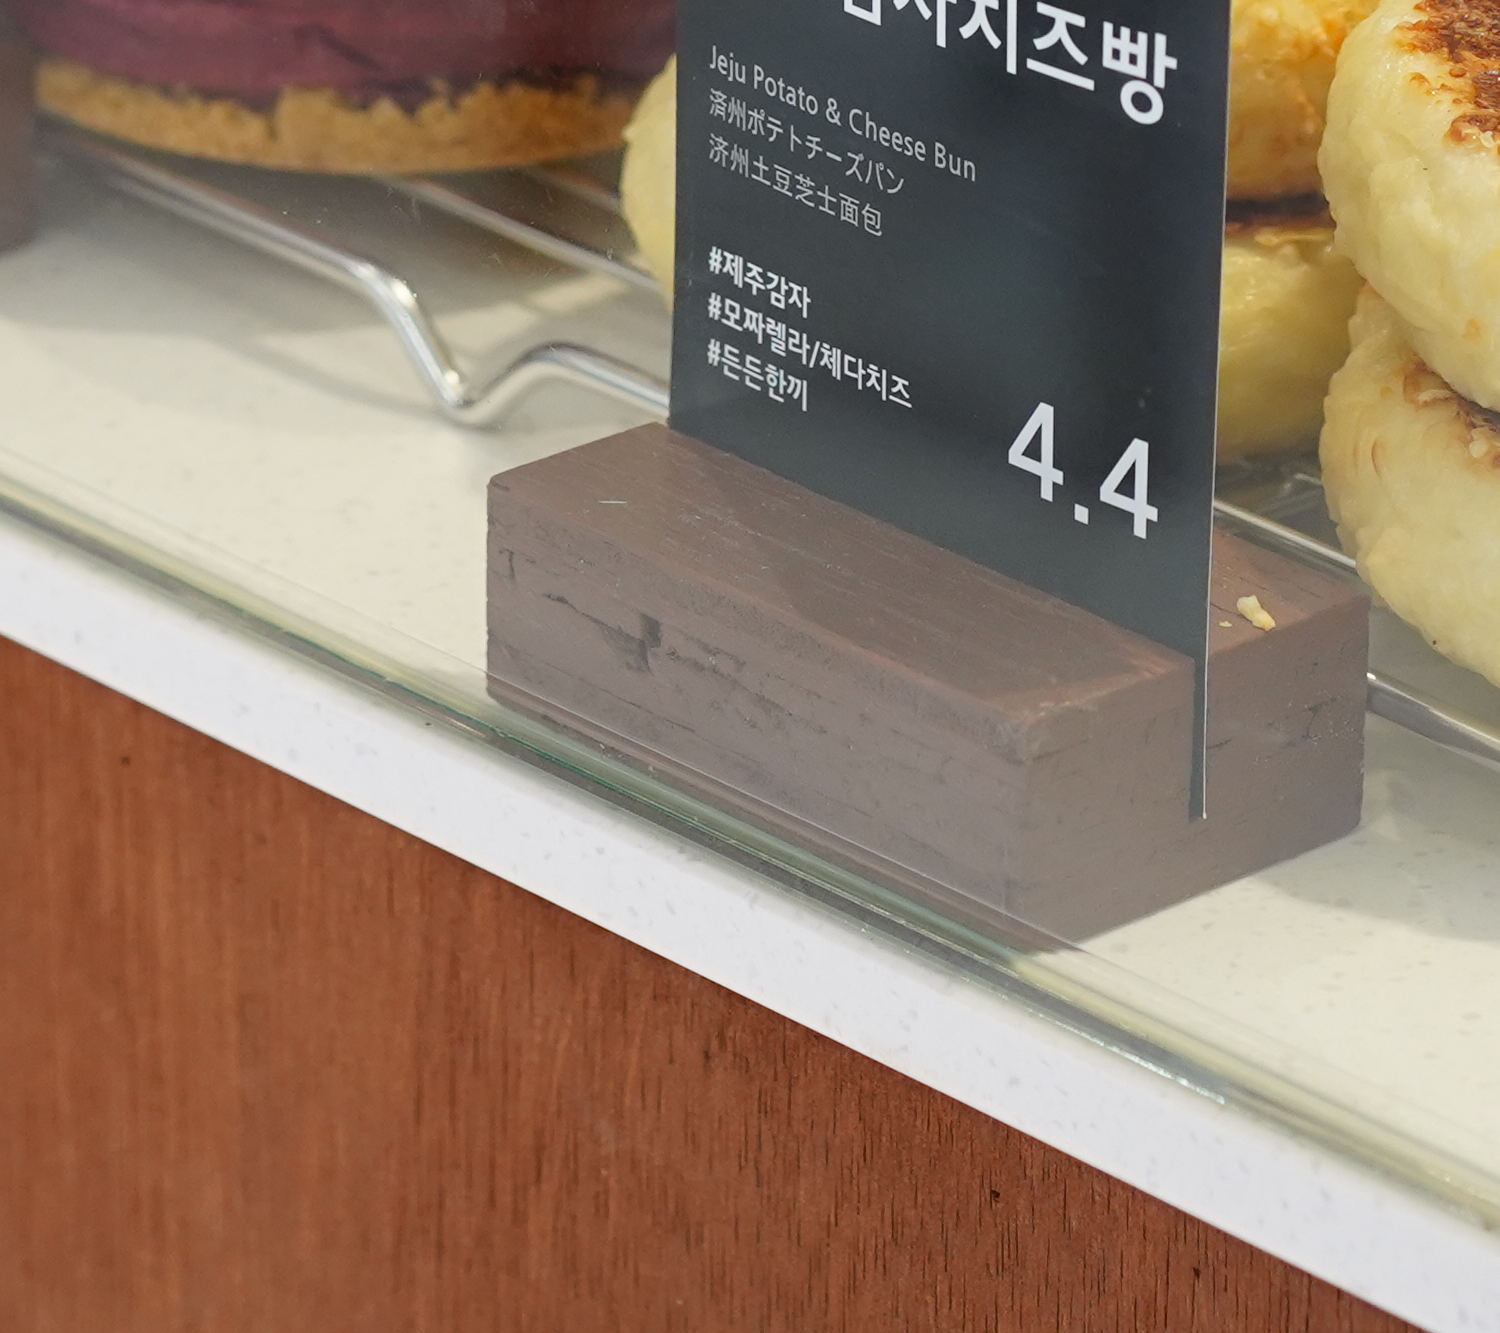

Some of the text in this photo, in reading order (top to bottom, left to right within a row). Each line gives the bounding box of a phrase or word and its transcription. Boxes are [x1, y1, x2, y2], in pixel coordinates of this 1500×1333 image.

[709, 45, 976, 182] Jeju Potato & Cheese Bun
[709, 87, 904, 194] 済州ポテトチーズパン
[709, 133, 883, 237] 济州土豆芝士面包
[708, 246, 811, 319] #제주감자
[707, 338, 808, 412] #든든한끼
[708, 291, 913, 408] #모짜렐라/체다치즈
[1007, 401, 1159, 540] 4.4
